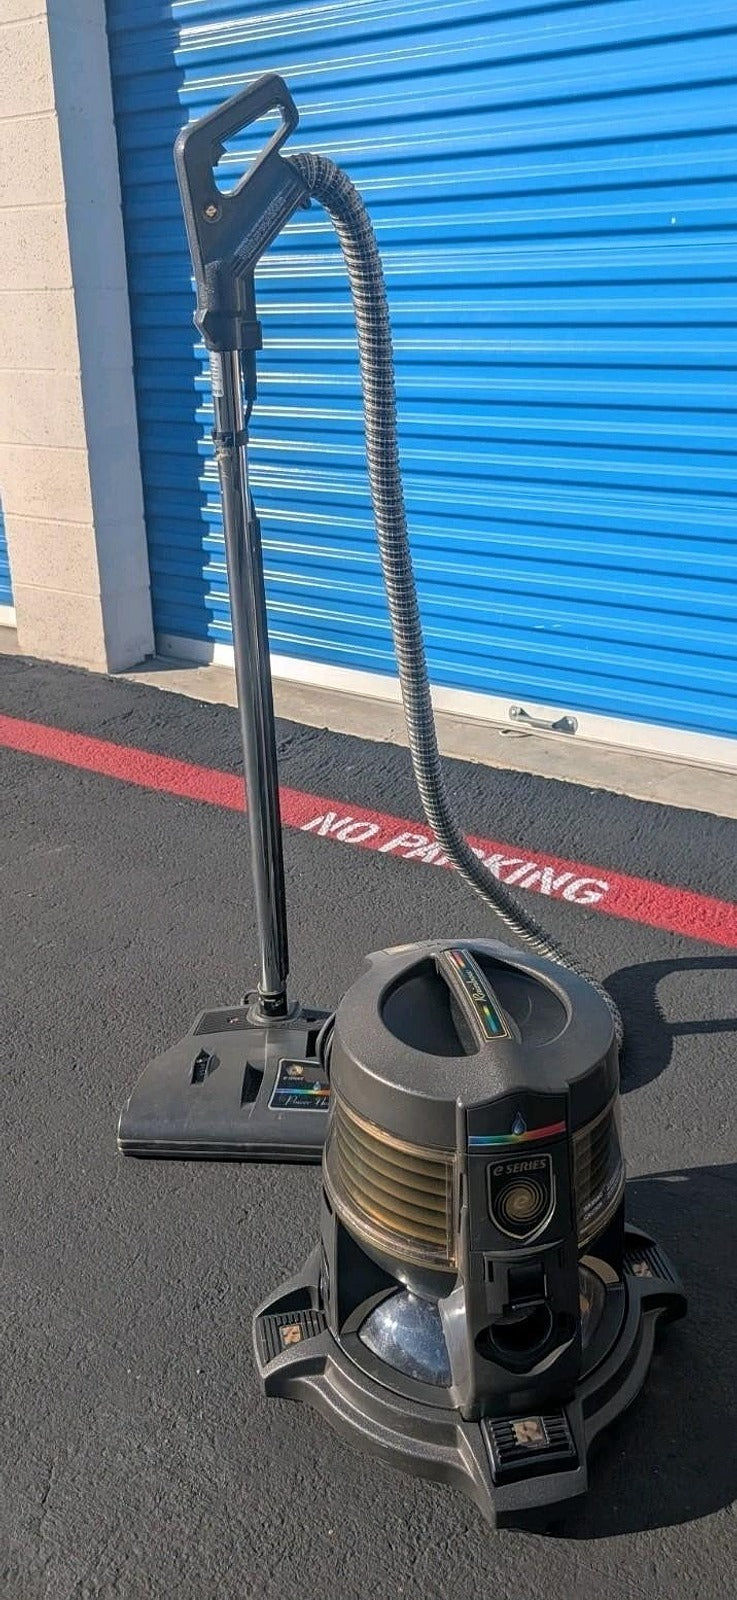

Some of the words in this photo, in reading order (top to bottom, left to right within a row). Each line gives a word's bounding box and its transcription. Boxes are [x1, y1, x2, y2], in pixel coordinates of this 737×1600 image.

[301, 811, 379, 843] NO
[377, 831, 610, 905] PAKING
[506, 1159, 547, 1175] SERIES
